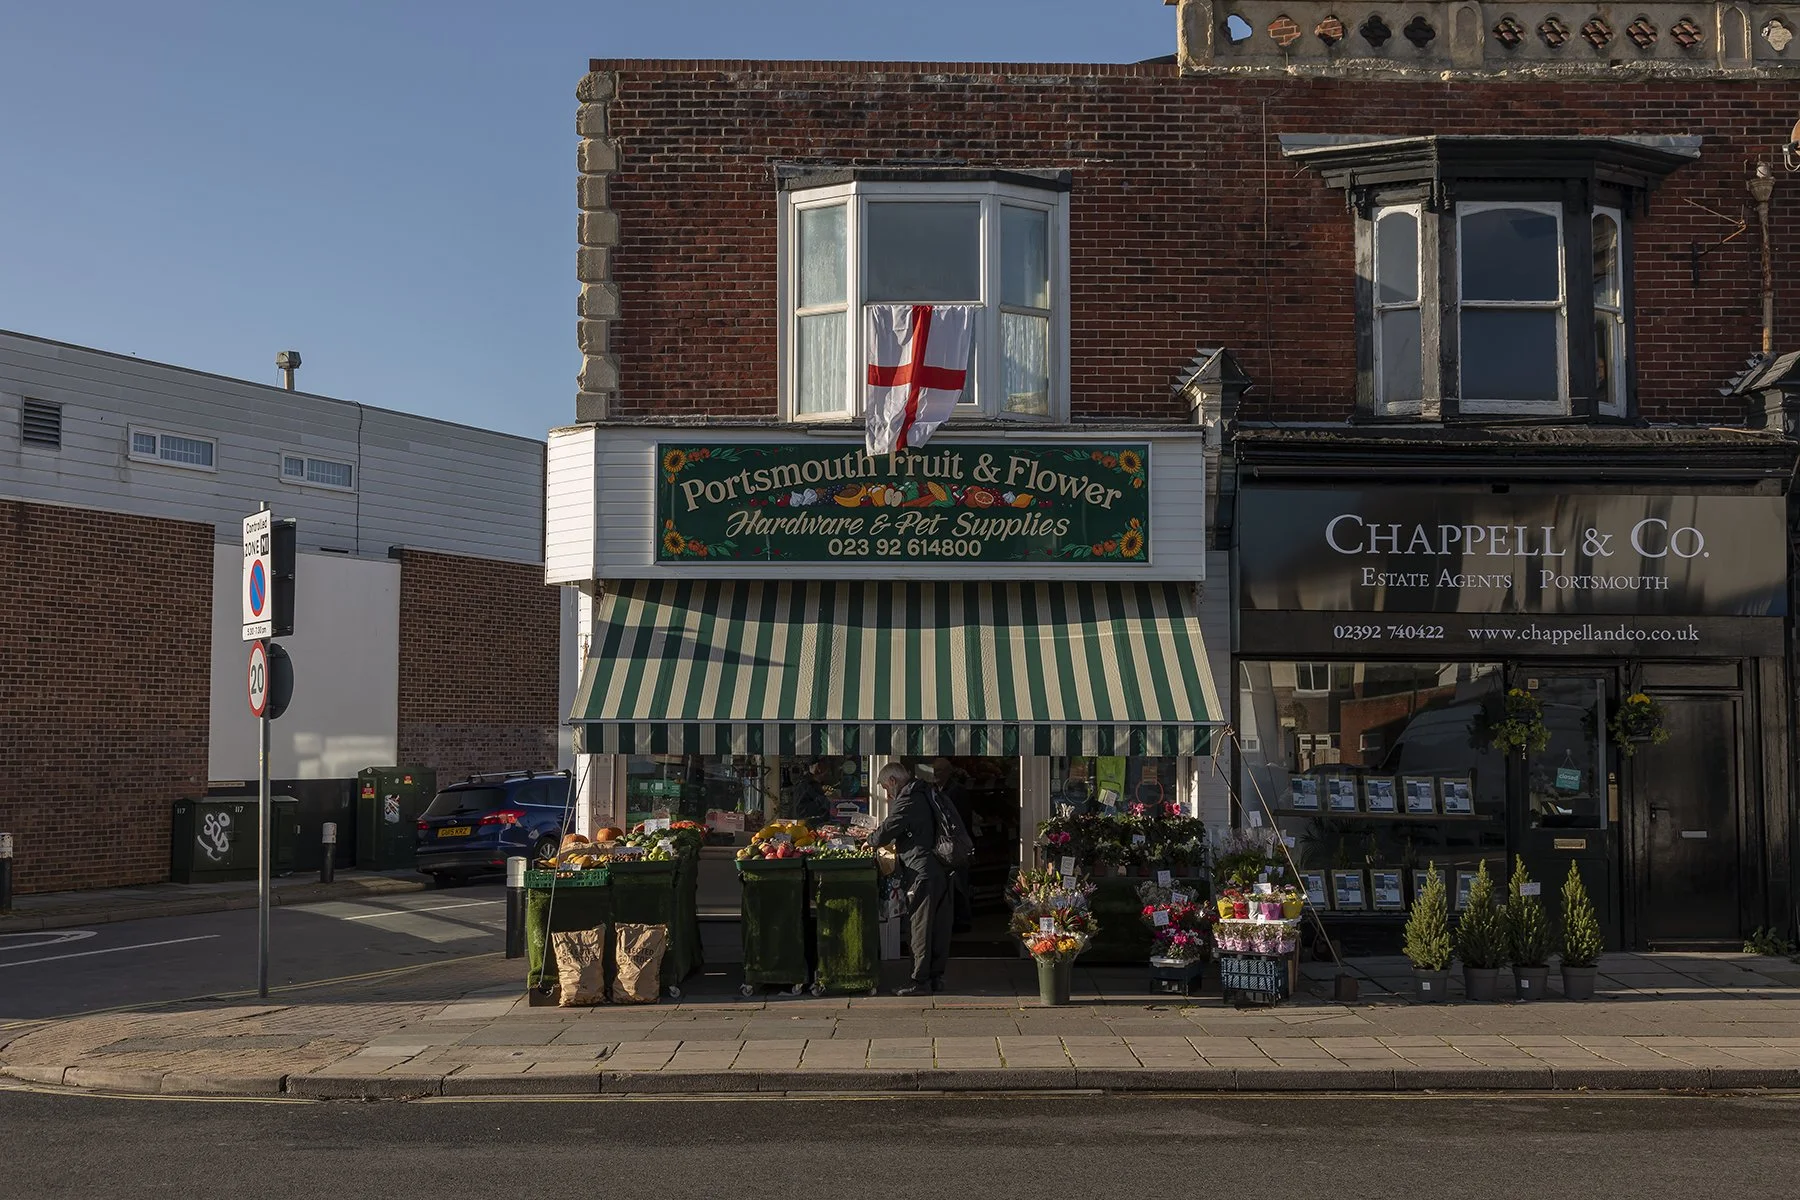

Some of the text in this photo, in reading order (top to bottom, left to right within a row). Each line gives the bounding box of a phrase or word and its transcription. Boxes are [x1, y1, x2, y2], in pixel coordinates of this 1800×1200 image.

[680, 448, 1122, 511] Portsmouth Fruit & Flower
[246, 515, 267, 534] Controlled
[726, 509, 1070, 542] Hardware & Pet Supplies
[1325, 514, 1567, 556] CHAPPELL
[1582, 528, 1614, 557] &
[245, 539, 259, 557] ZONE
[828, 538, 982, 557] 023 92 614800
[1361, 567, 1669, 590] ESTATE AGENTS PORTSMOUTH
[1333, 623, 1700, 646] 02392 740422 www.chappellandco.co.uk
[250, 664, 264, 694] 20
